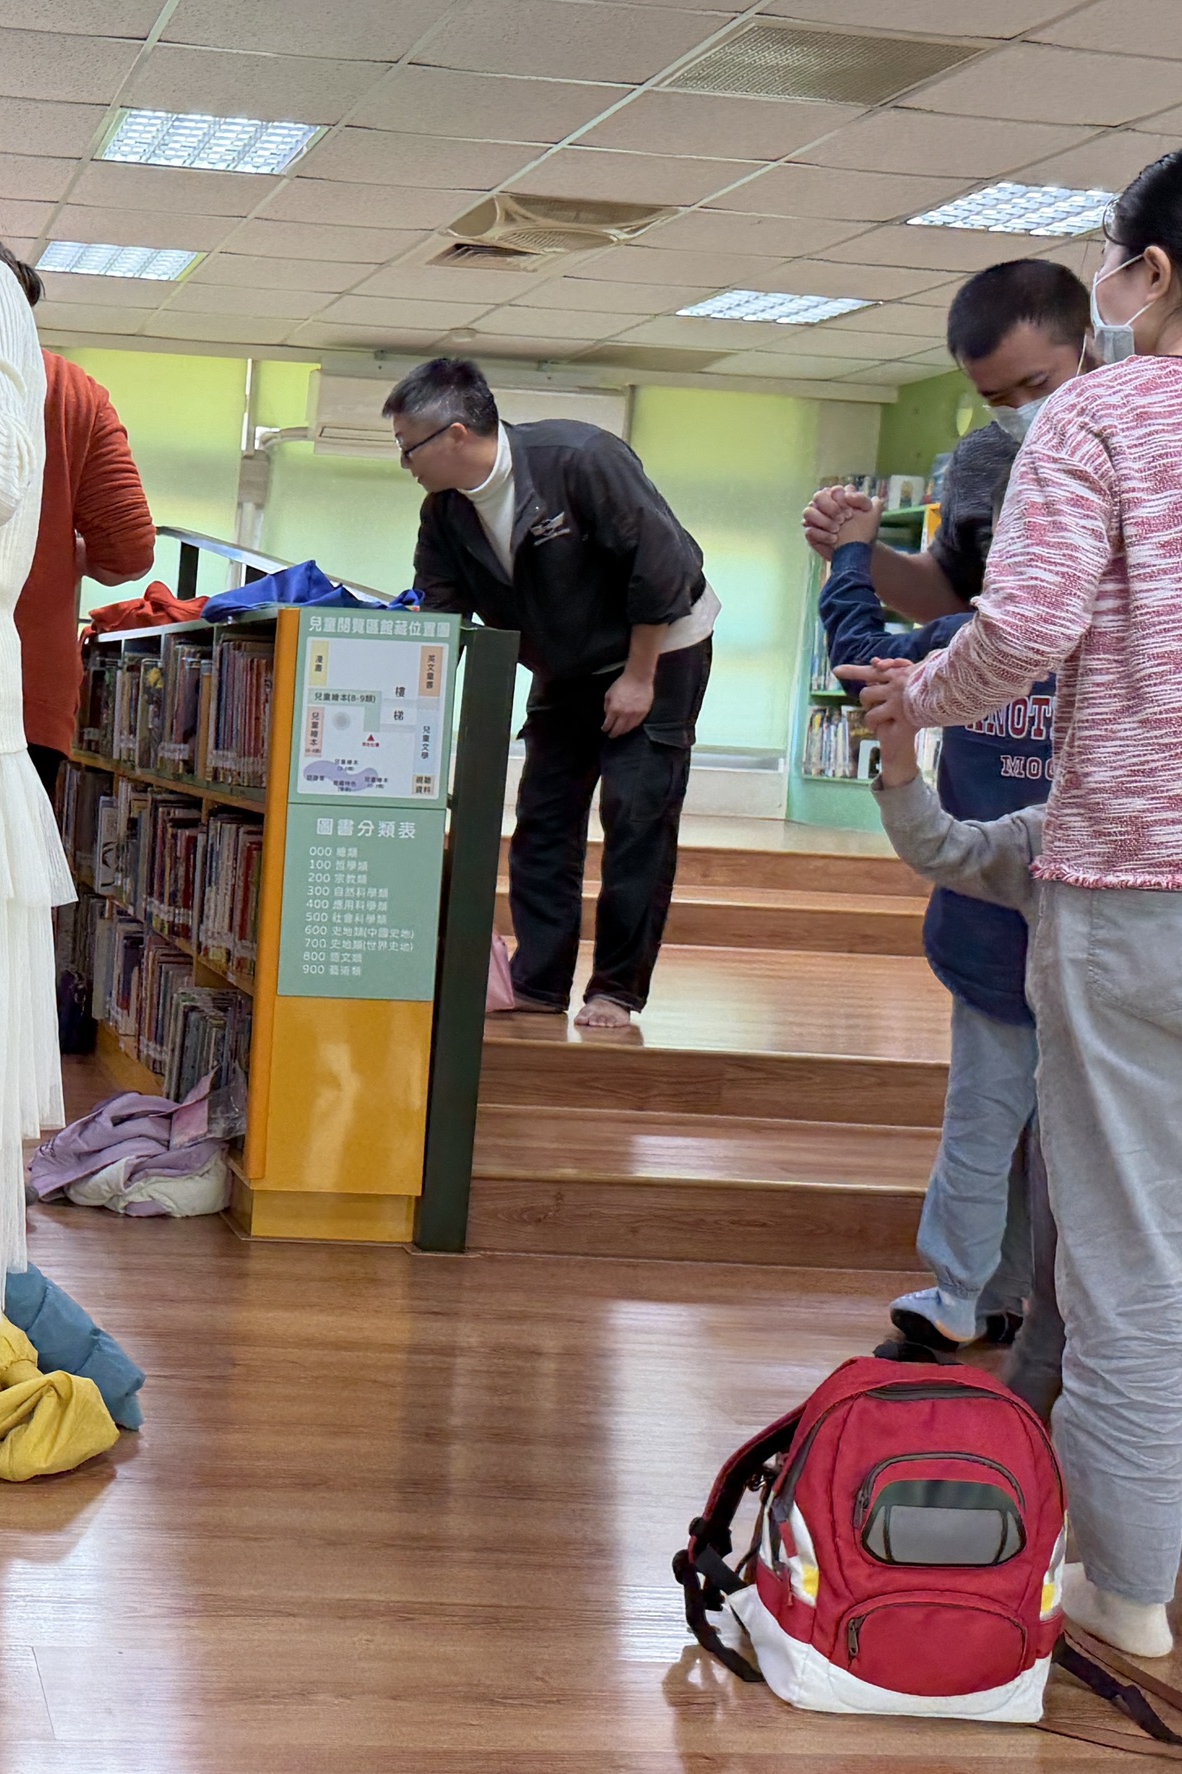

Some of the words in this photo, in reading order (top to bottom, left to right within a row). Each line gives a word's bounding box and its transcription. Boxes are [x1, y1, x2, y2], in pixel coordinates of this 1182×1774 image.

[316, 818, 416, 839] 圖書分類表
[309, 847, 332, 857] 000
[310, 860, 331, 870] 100
[308, 873, 331, 883] 200
[307, 886, 330, 896] 300
[306, 899, 329, 909] 400
[305, 912, 328, 922] 500
[304, 925, 327, 935] 600
[304, 938, 327, 948] 700
[303, 951, 326, 961] 800
[302, 964, 325, 975] 900
